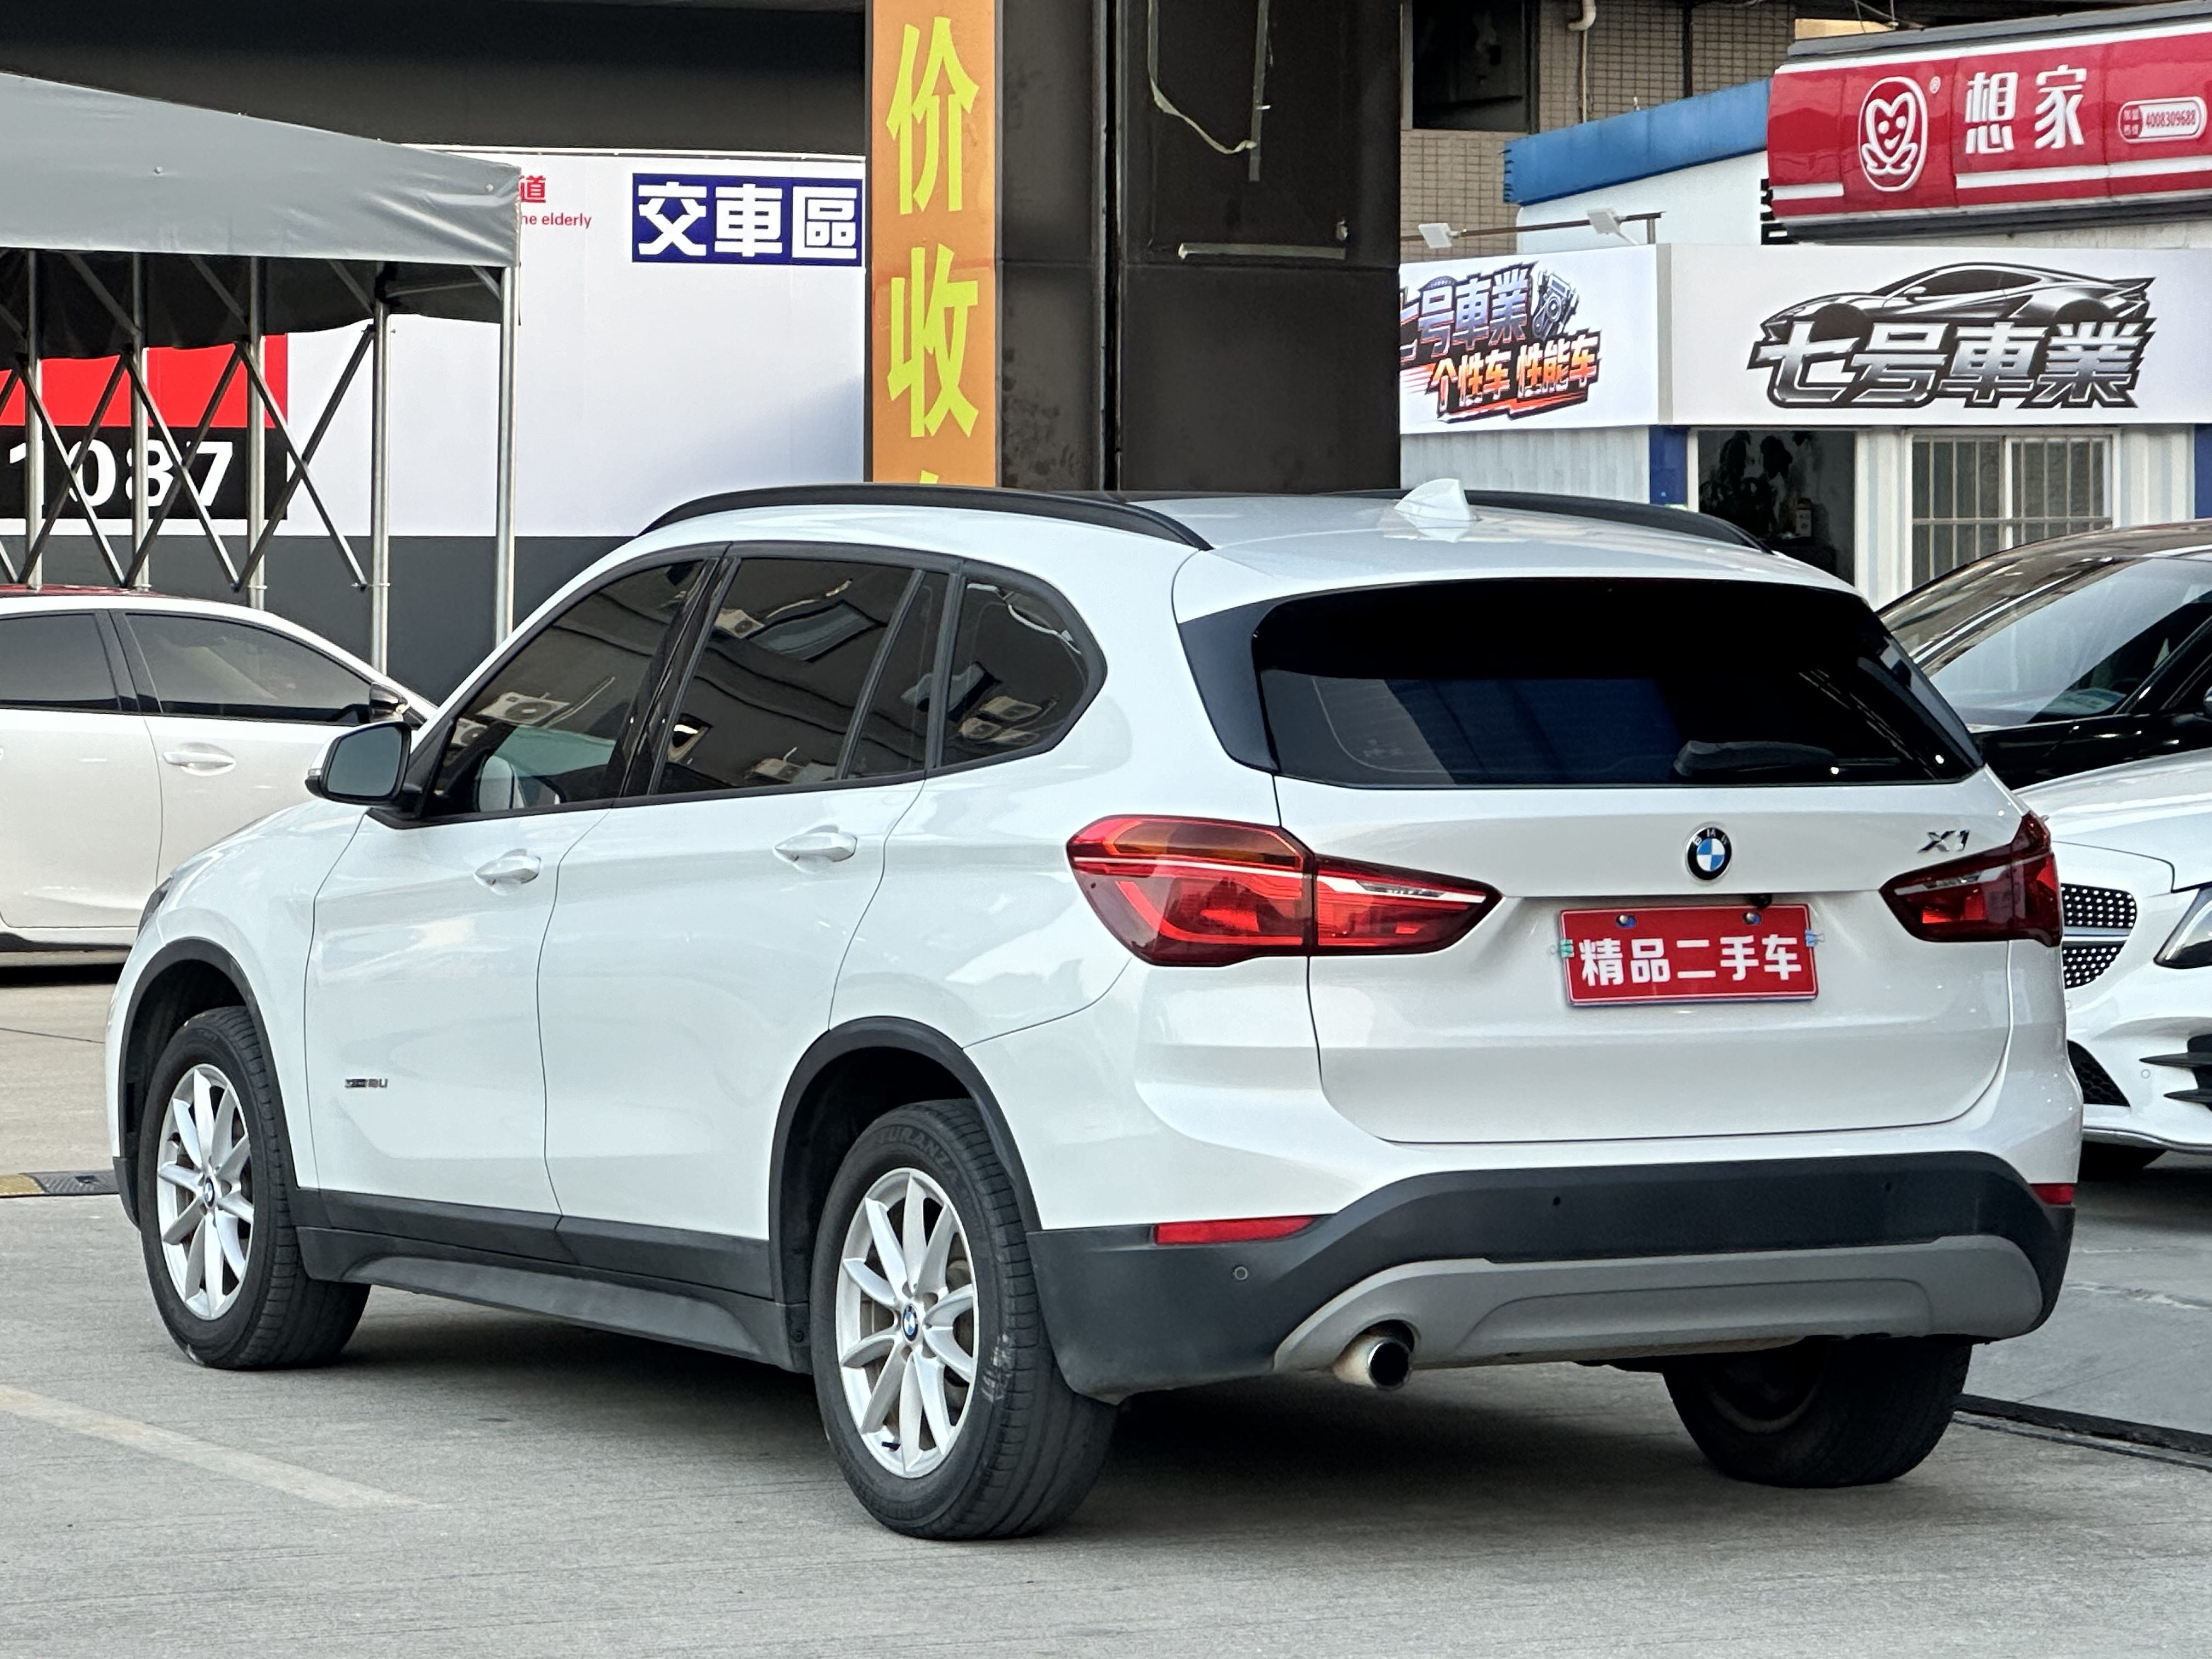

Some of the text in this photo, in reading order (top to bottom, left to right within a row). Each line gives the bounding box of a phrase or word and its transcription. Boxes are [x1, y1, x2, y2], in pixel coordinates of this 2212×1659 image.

[1964, 64, 2086, 155] 想家
[541, 212, 592, 229] elderly
[637, 181, 857, 259] 交車區
[886, 16, 980, 483] 价收
[1430, 334, 1600, 413] 个性车 性能车
[1757, 321, 2138, 403] 七号車業
[1917, 830, 1971, 853] X1
[1578, 934, 1802, 987] 精品二手车
